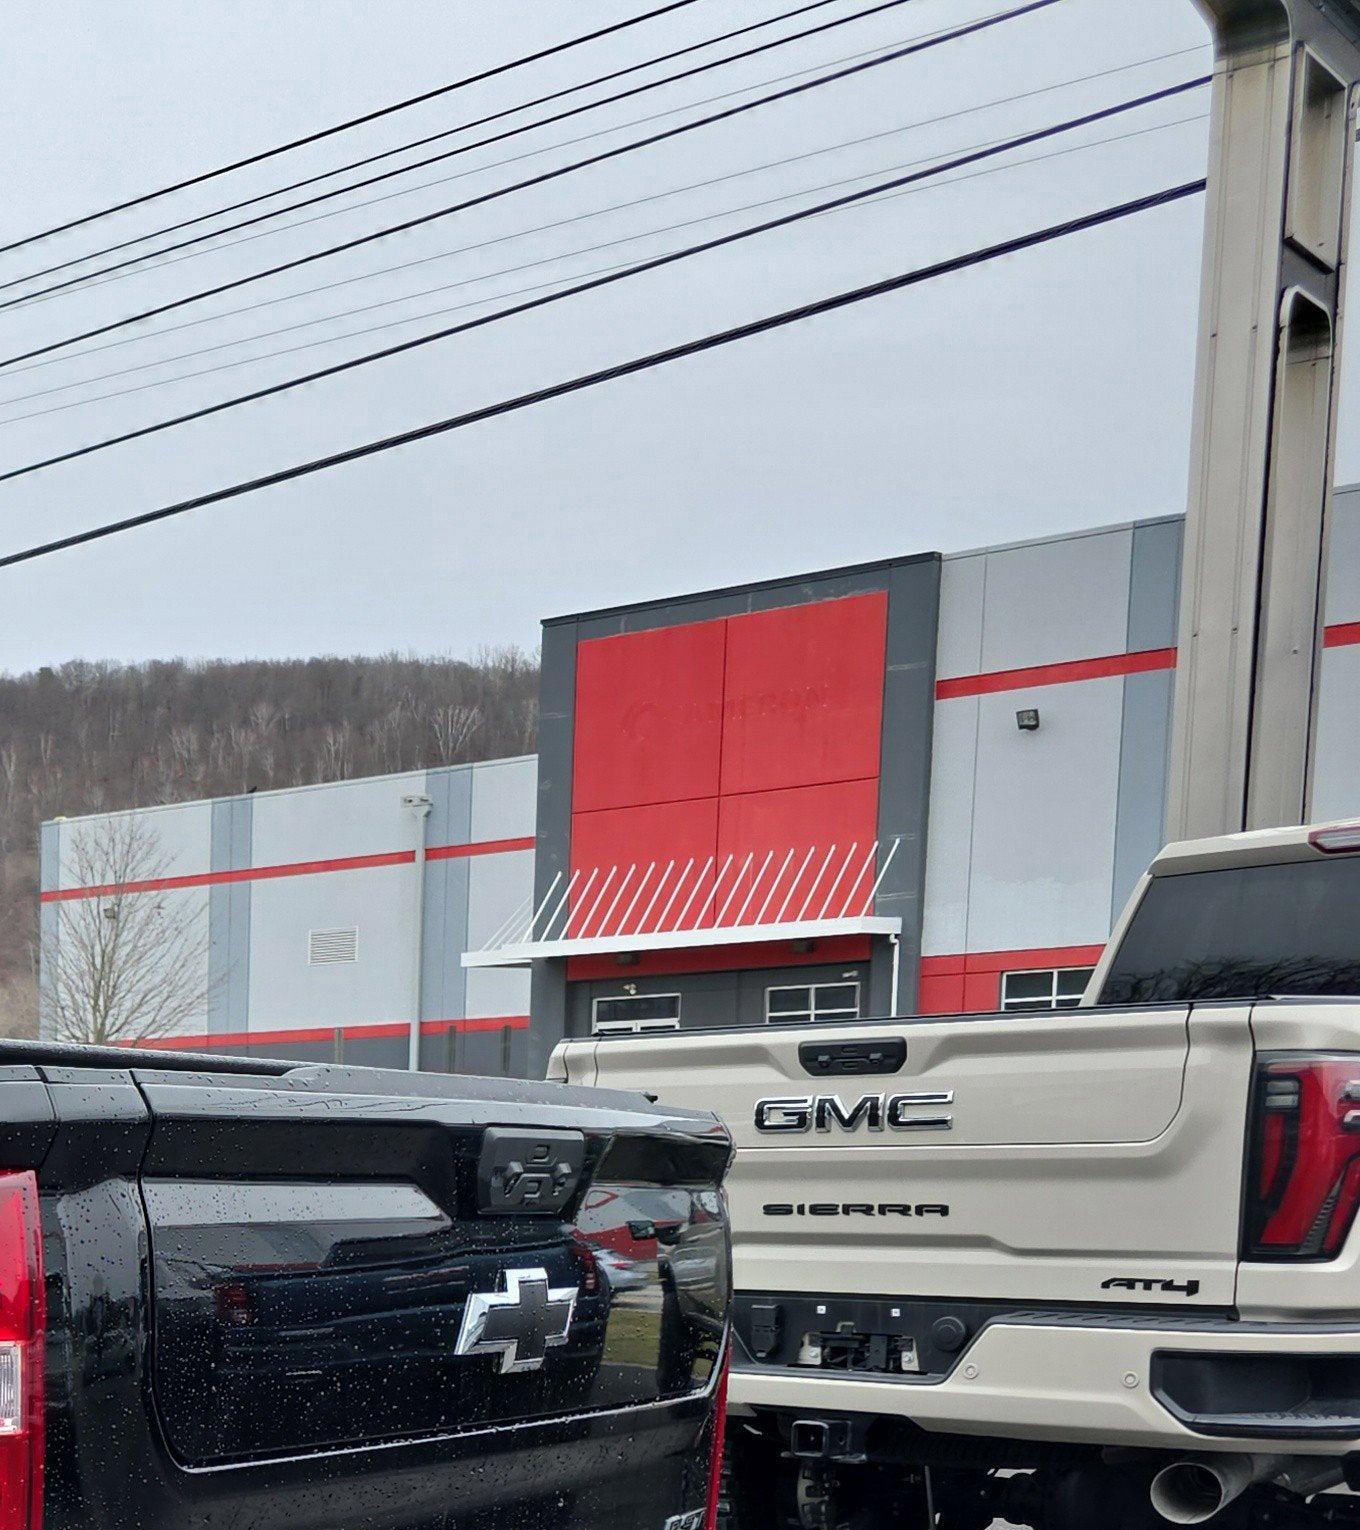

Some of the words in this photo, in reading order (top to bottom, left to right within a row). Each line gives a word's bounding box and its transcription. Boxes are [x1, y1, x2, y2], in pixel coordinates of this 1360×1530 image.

[754, 1090, 954, 1134] GMC
[763, 1203, 950, 1218] SIERRA
[1100, 1277, 1199, 1297] AT4
